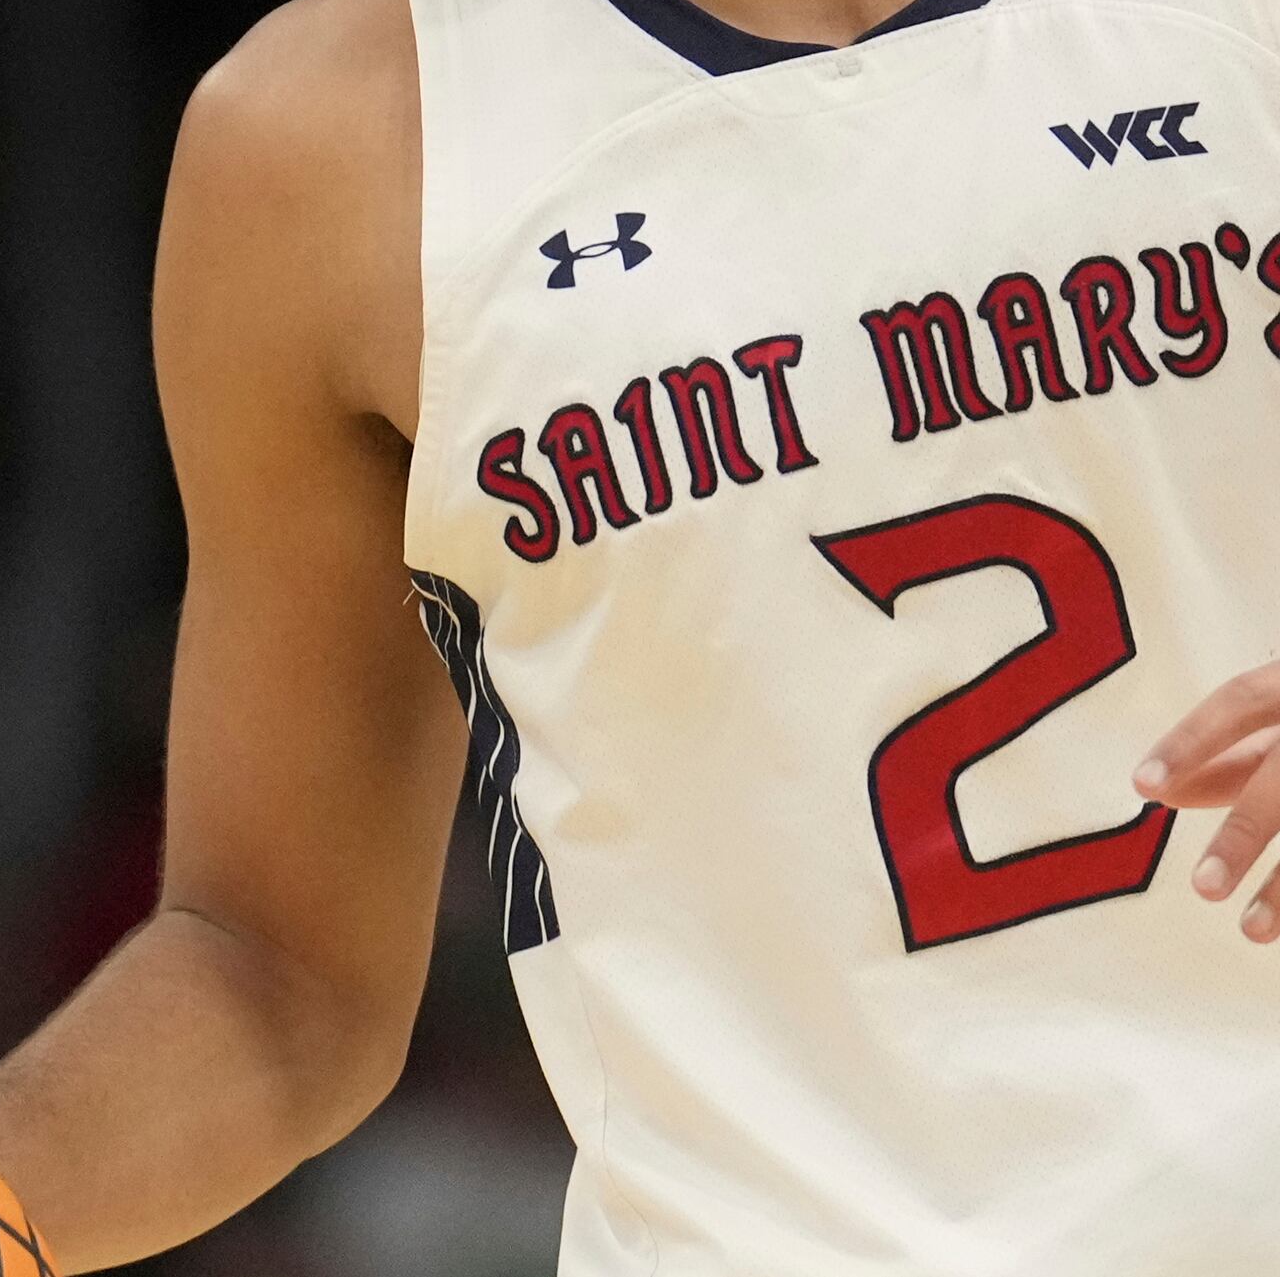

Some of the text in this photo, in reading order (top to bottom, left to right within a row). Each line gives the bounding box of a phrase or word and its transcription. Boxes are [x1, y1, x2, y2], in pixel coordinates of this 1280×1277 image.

[1049, 100, 1210, 169] WCC
[476, 333, 819, 563] SAINT
[810, 493, 1177, 953] 2
